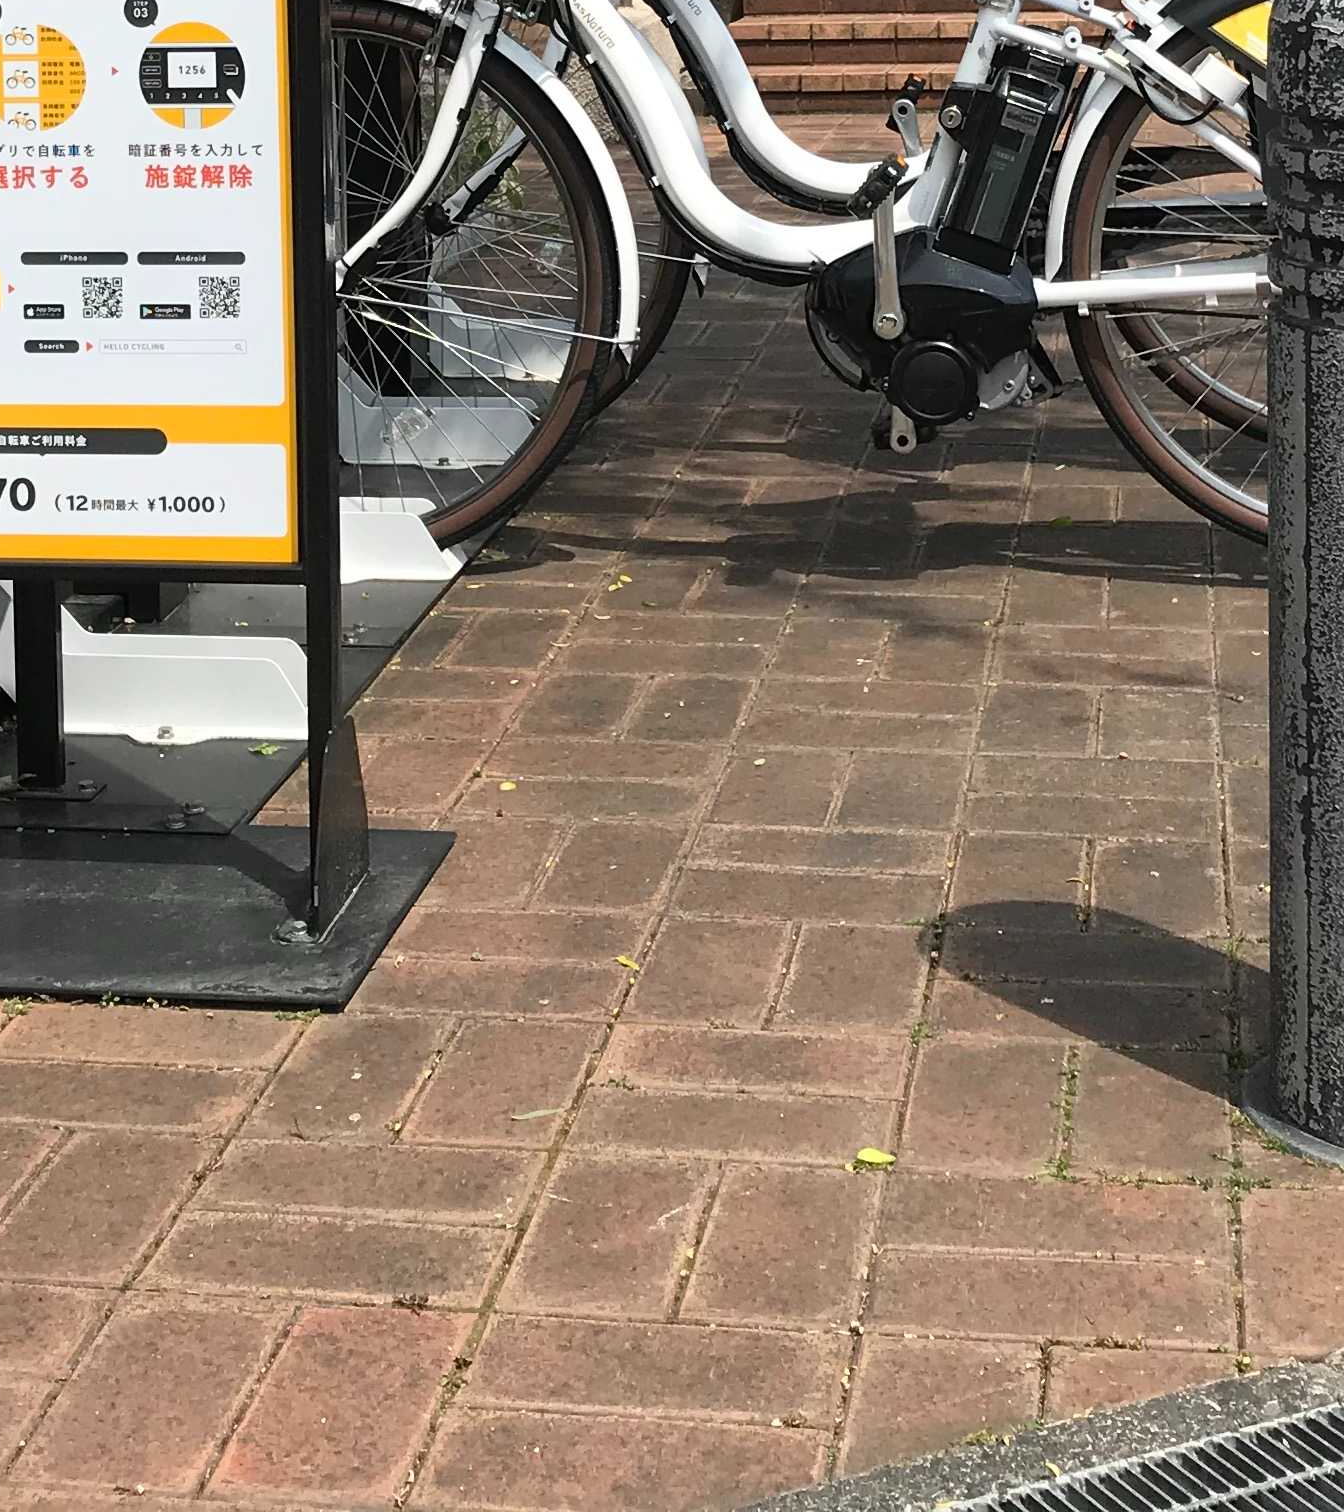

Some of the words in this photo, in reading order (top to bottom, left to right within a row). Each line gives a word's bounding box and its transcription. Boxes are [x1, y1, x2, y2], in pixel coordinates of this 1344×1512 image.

[133, 7, 149, 18] 03
[178, 65, 206, 75] 1256
[128, 143, 264, 158] 暗証番号を入力して
[144, 164, 253, 189] 施錠解除
[59, 254, 88, 262] iPhone
[174, 254, 208, 262] Android
[38, 342, 65, 350] Search
[103, 343, 129, 351] HELLO
[131, 343, 165, 351] CYCLING
